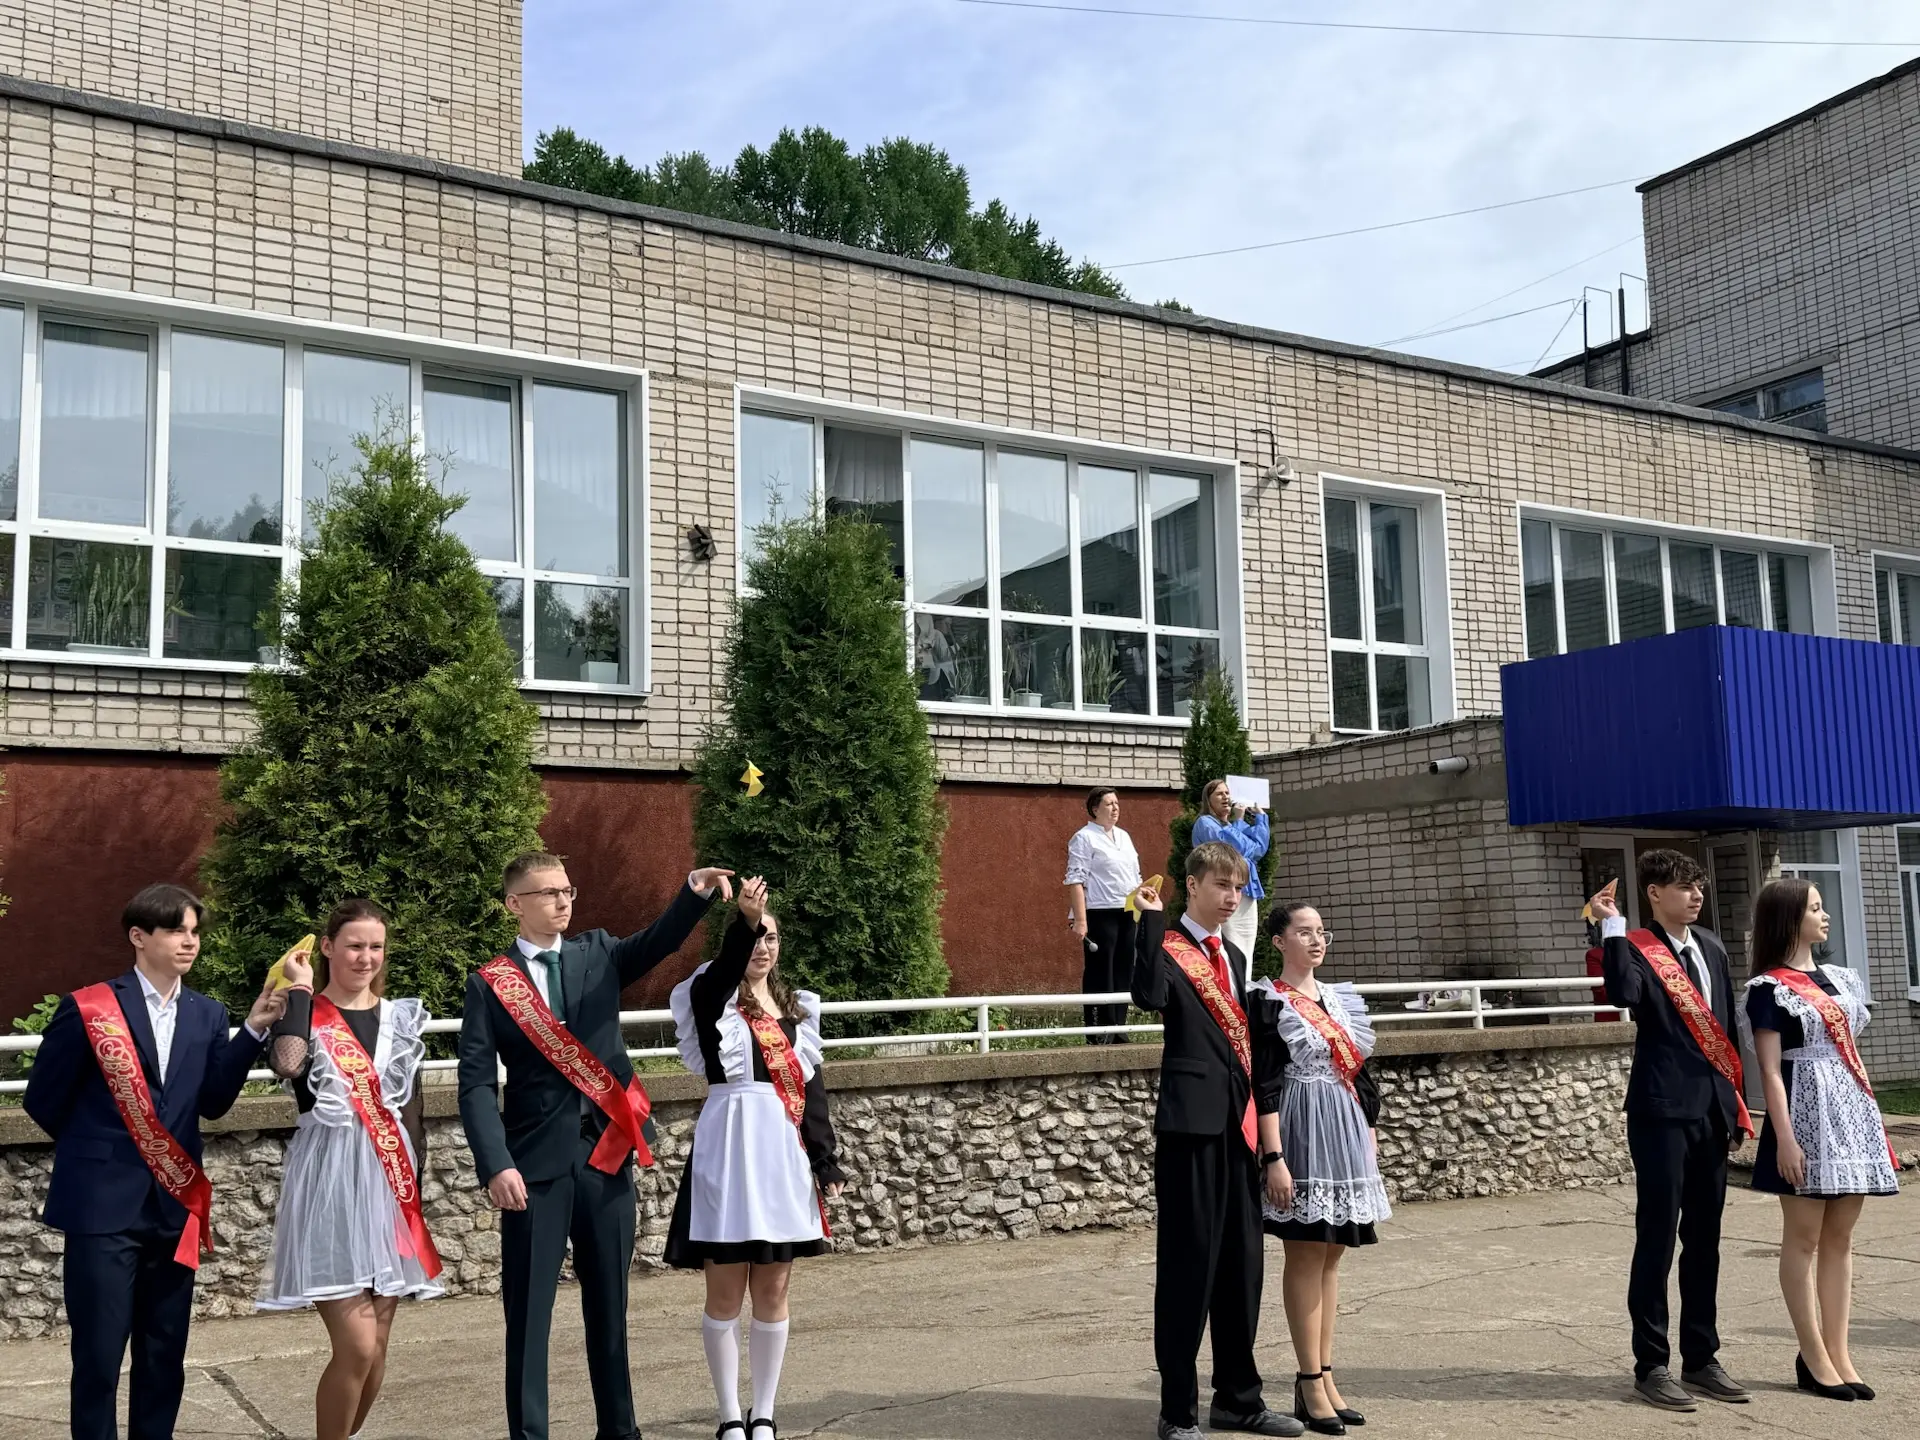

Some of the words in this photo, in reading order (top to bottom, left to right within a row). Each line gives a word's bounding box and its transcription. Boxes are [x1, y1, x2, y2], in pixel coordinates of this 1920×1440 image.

[493, 973, 564, 1051] Выпускник
[551, 1044, 579, 1062] 9
[1228, 1025, 1246, 1040] 9
[1658, 964, 1716, 1042] Выпускник
[1703, 1040, 1727, 1053] 9
[96, 1036, 154, 1142] Выпускник
[140, 1139, 170, 1157] 9
[331, 1040, 389, 1136] Выпускник
[377, 1134, 400, 1151] 9
